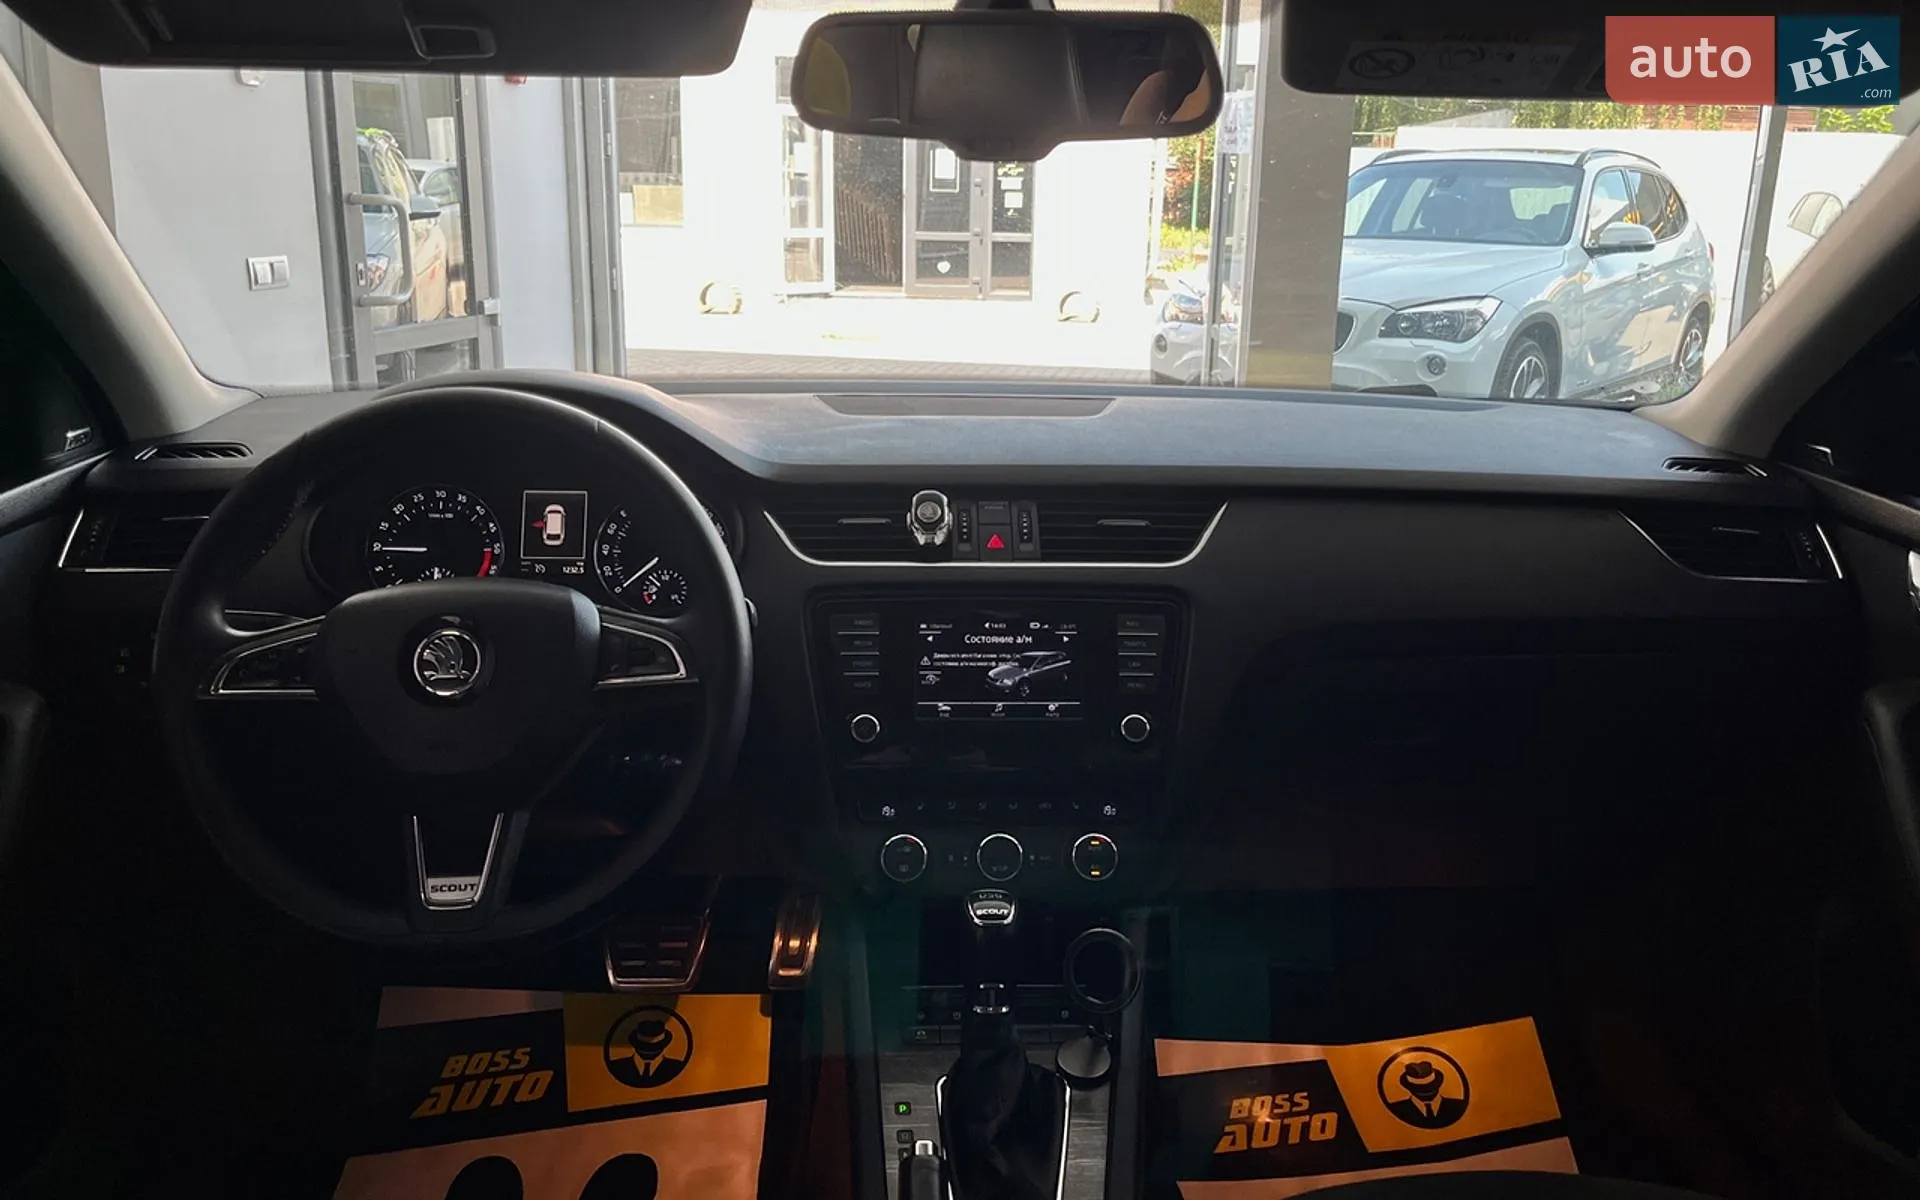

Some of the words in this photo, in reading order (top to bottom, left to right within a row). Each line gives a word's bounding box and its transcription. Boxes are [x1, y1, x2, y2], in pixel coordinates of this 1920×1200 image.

[412, 492, 425, 504] 25
[435, 489, 447, 499] 30
[392, 503, 405, 516] 20
[475, 505, 487, 517] 40
[379, 520, 390, 532] 15
[601, 543, 610, 556] 40
[602, 565, 614, 578] 20
[614, 585, 623, 595] 0
[963, 634, 1015, 645] Состояние
[1016, 634, 1033, 645] а/м
[430, 883, 477, 893] SCOUT
[975, 907, 1010, 917] SCOUT
[440, 1047, 532, 1079] BOSS
[408, 1069, 555, 1120] AUTO
[899, 1103, 908, 1113] P
[1229, 1091, 1311, 1120] BOSS
[1213, 1111, 1339, 1154] AUTO
